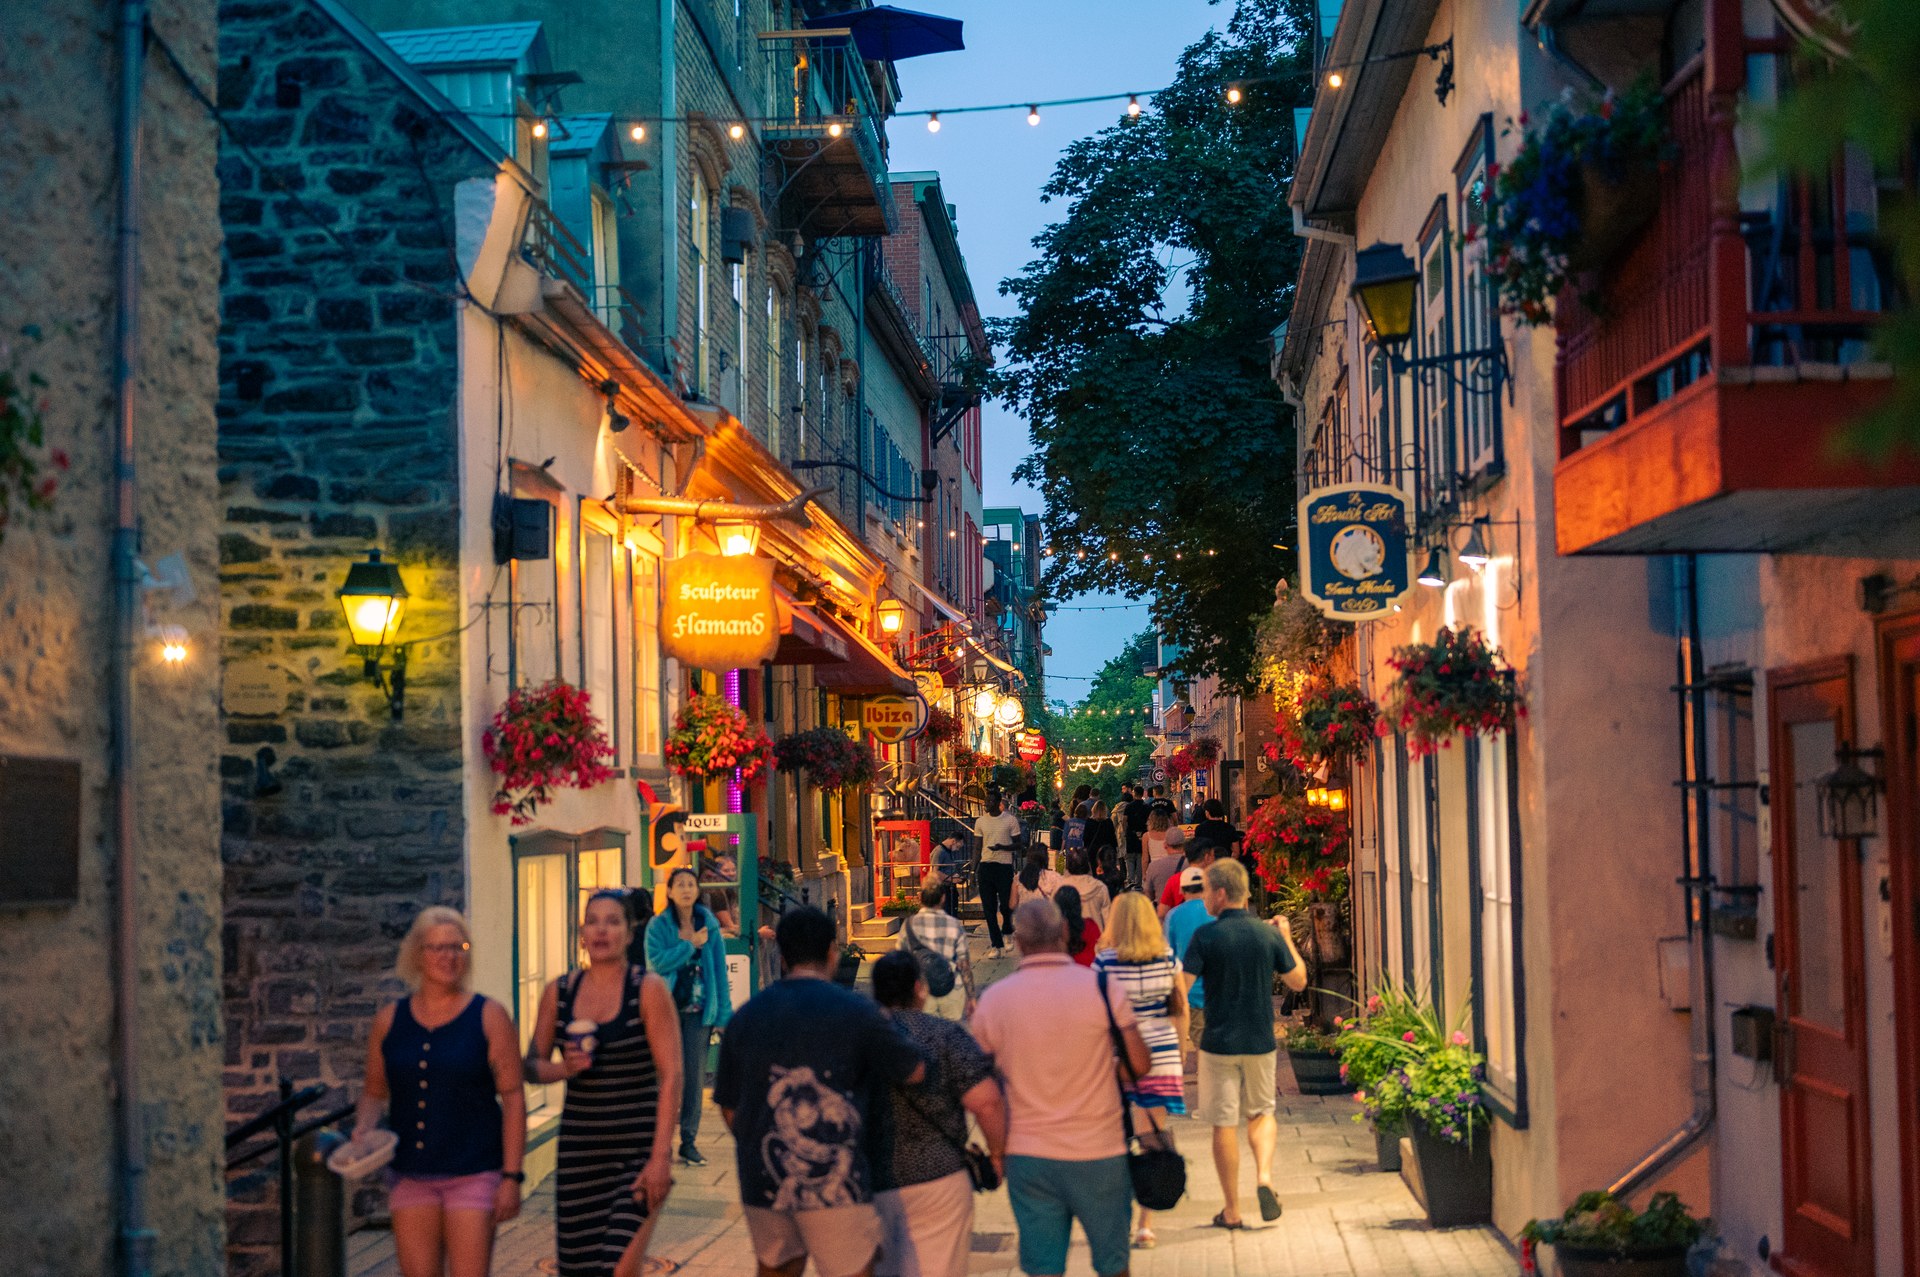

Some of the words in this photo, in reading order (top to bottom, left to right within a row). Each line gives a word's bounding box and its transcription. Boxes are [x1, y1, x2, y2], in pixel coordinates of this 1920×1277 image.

[679, 581, 761, 603] Sculpteur
[672, 612, 766, 639] Flamand
[866, 706, 914, 723] Ibiza
[689, 818, 721, 828] IQUE
